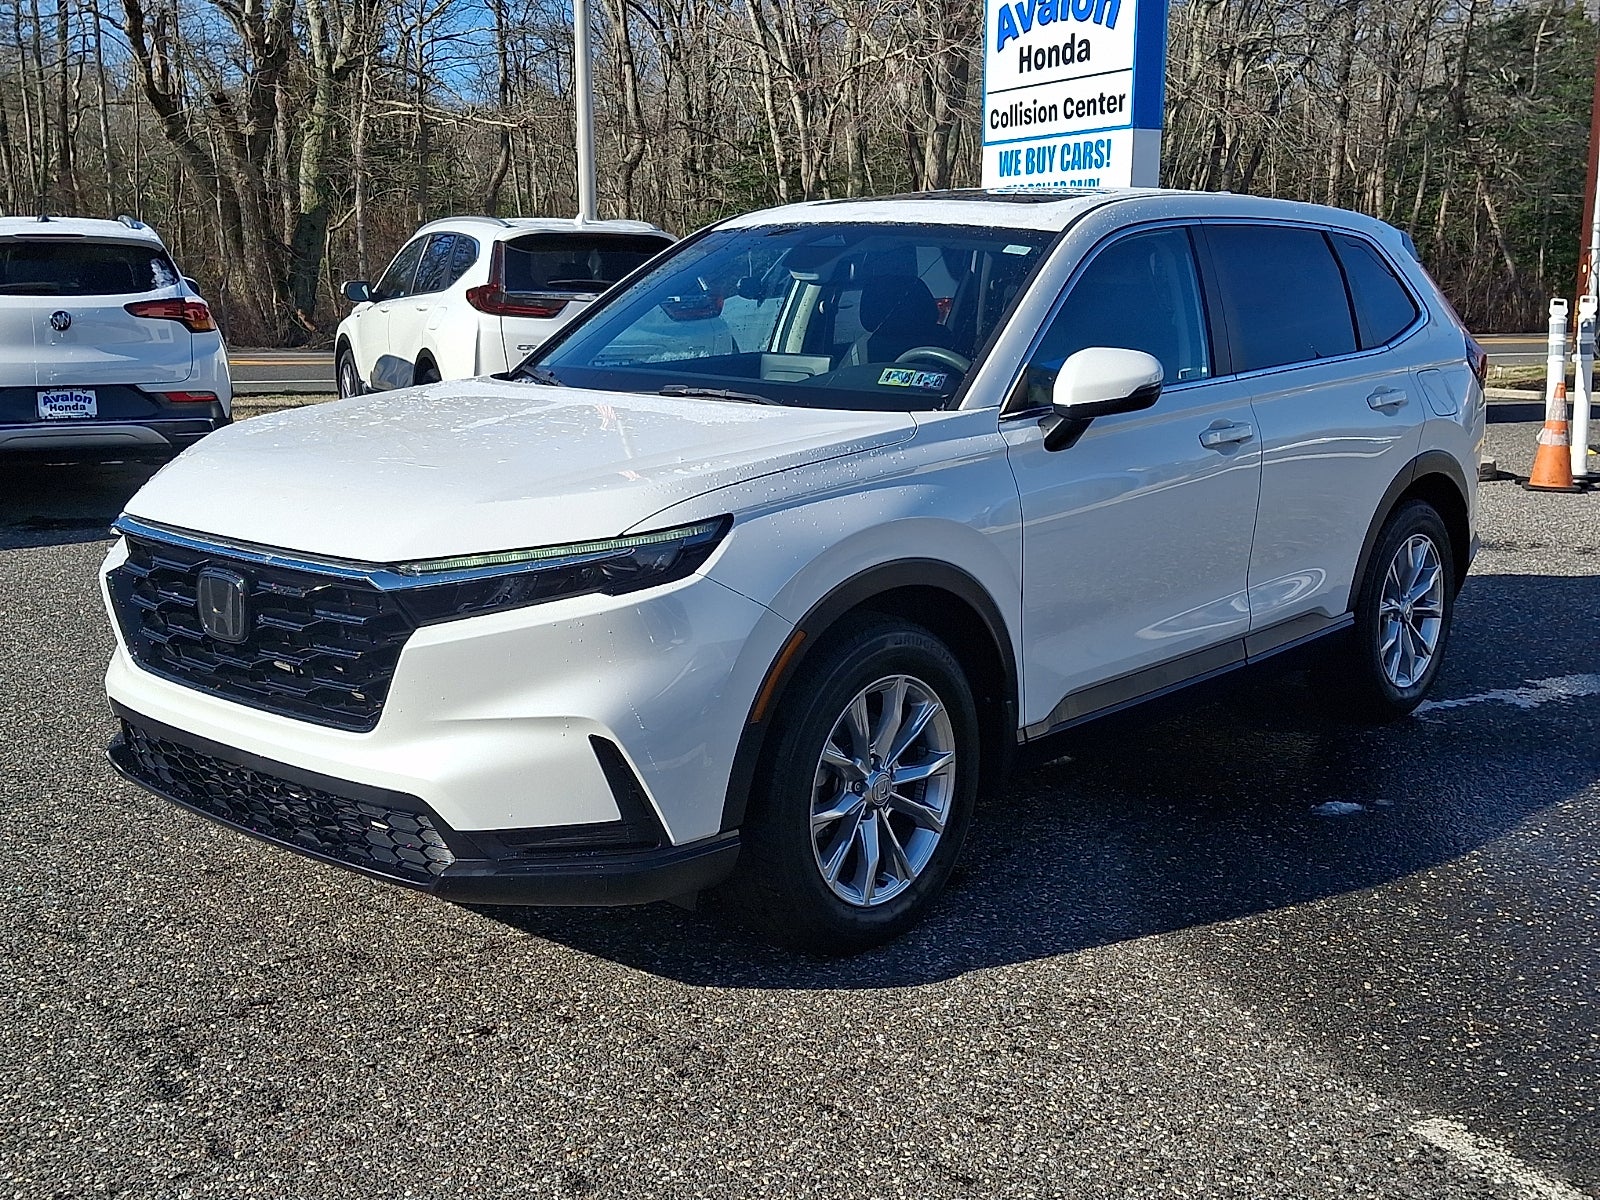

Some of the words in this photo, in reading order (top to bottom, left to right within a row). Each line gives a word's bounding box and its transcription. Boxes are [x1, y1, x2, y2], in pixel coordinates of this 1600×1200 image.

[997, 0, 1121, 53] Avalon
[1019, 33, 1091, 74] Honda
[990, 99, 1058, 129] Collision
[1063, 92, 1126, 119] Center
[999, 149, 1021, 177] WE
[1025, 145, 1056, 174] BUY
[1060, 139, 1112, 171] CARS!
[42, 392, 92, 406] Avalon
[50, 403, 86, 411] Honda
